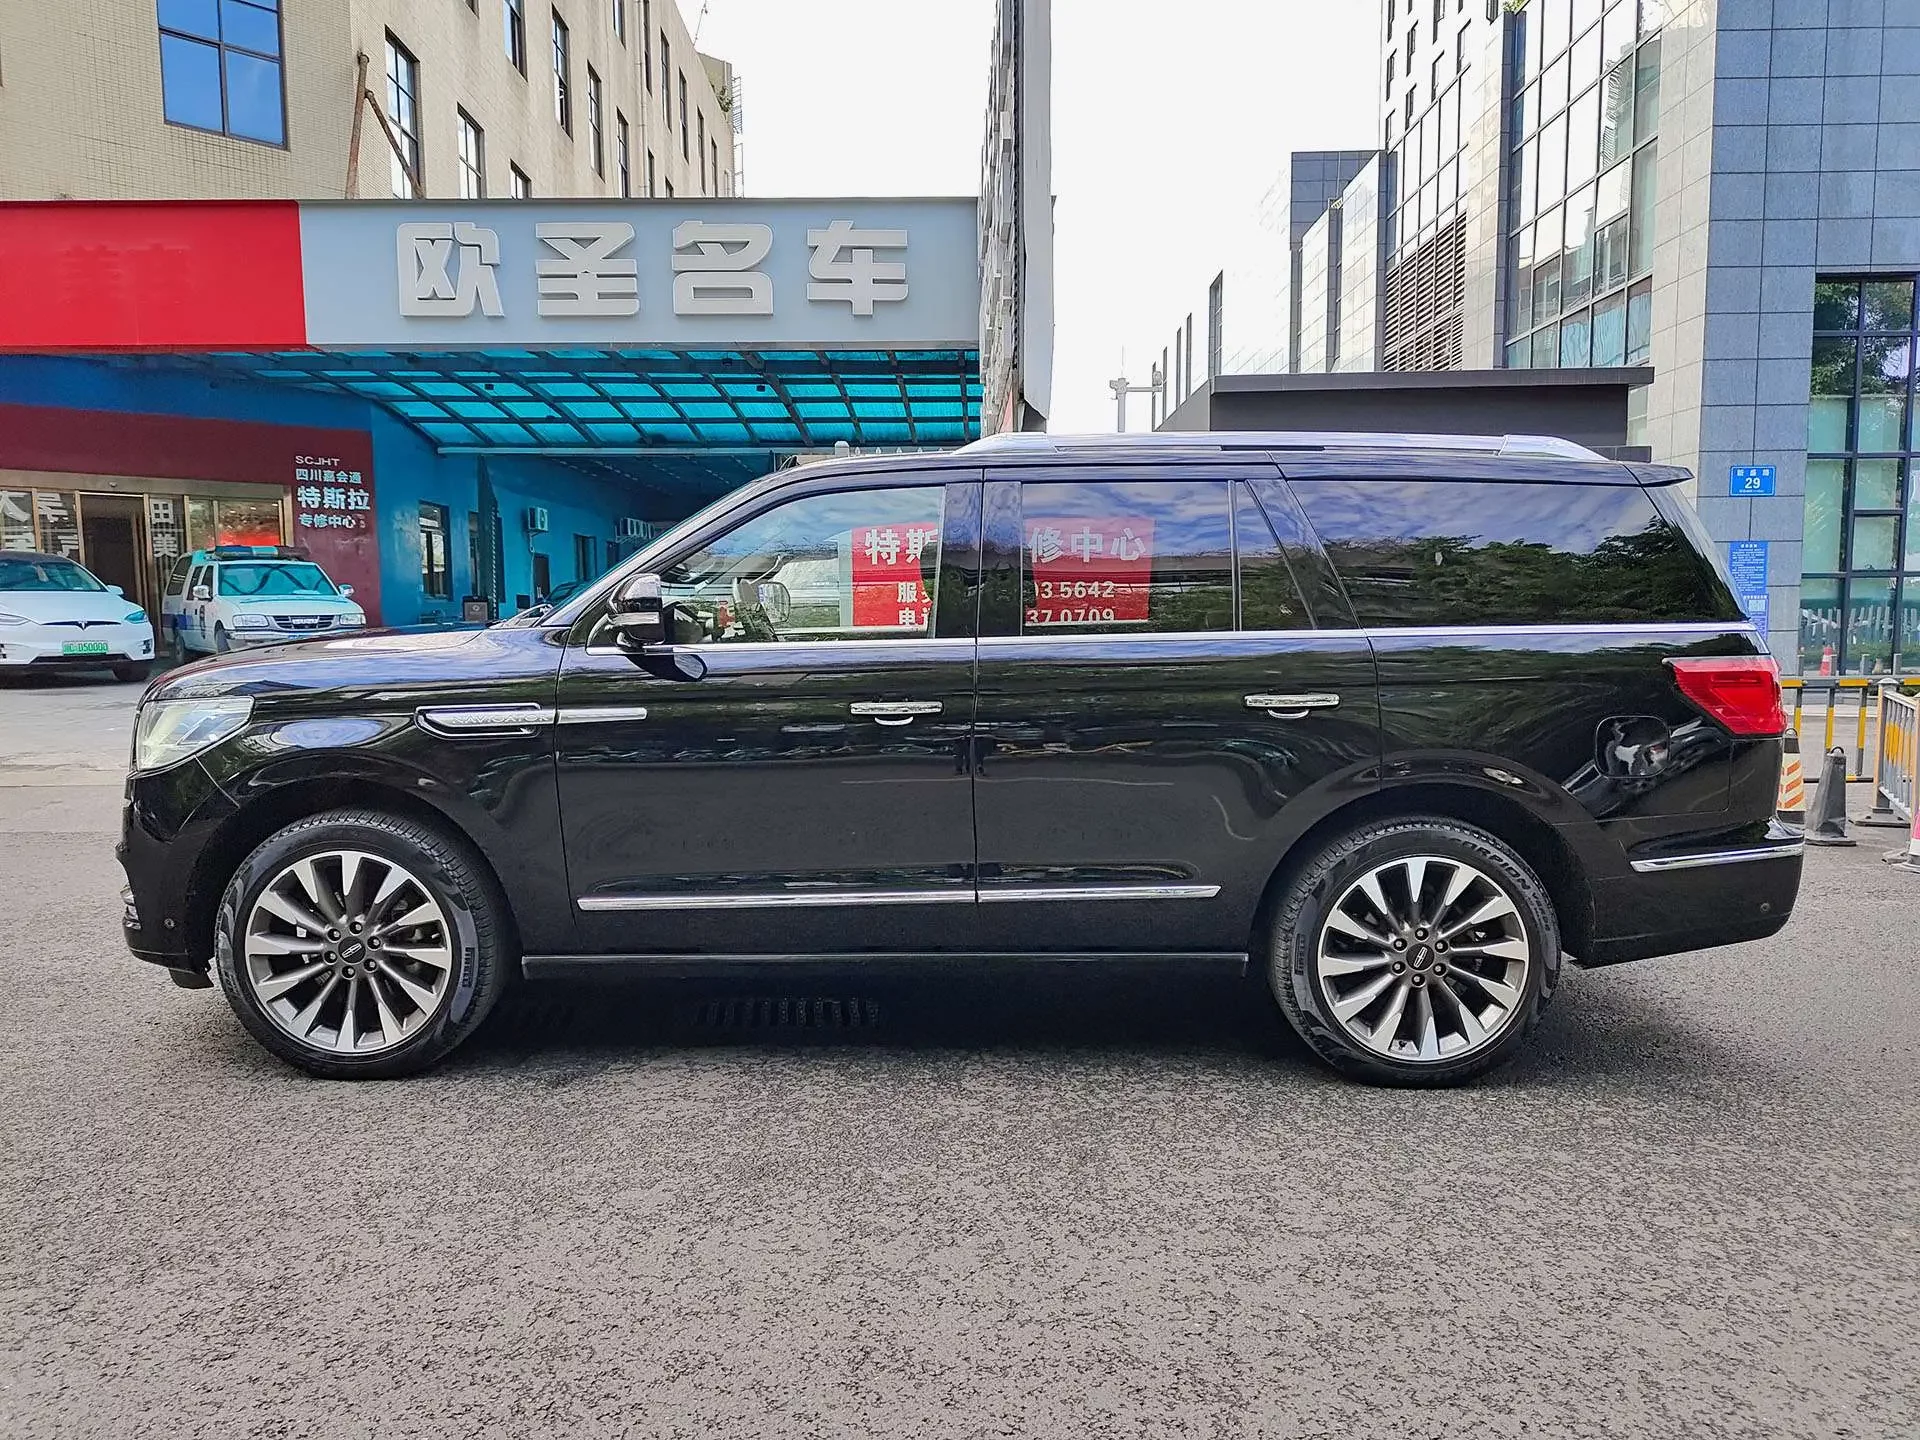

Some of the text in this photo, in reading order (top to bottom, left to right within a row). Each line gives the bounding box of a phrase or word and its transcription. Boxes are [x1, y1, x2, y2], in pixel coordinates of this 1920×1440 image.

[396, 220, 909, 317] 欧圣名车
[1744, 477, 1761, 489] 29
[297, 485, 370, 510] 特斯拉
[298, 513, 356, 528] 专修中心
[1029, 527, 1146, 563] 修中心
[452, 713, 549, 724] NAVIGATOR
